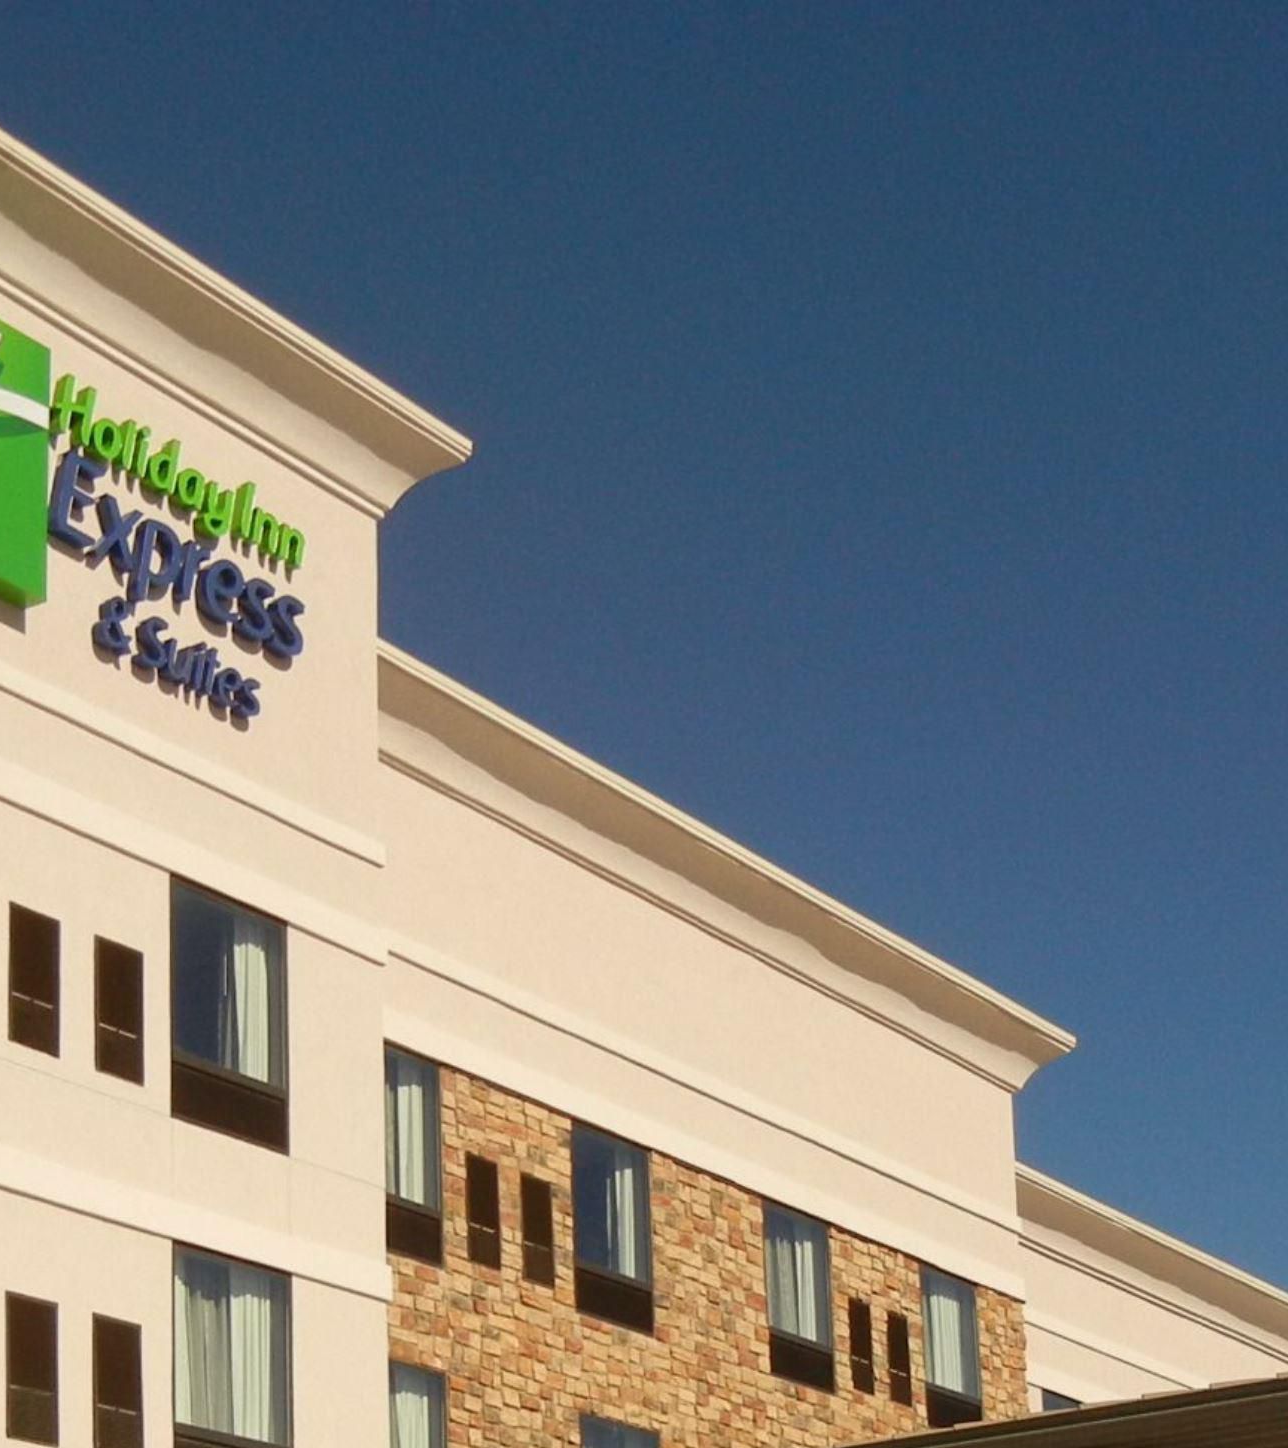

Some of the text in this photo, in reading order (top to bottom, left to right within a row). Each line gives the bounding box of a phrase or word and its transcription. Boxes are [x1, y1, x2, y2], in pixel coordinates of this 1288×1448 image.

[48, 450, 305, 657] Express
[51, 373, 305, 570] Holiday Inn
[91, 596, 261, 718] & Suites
